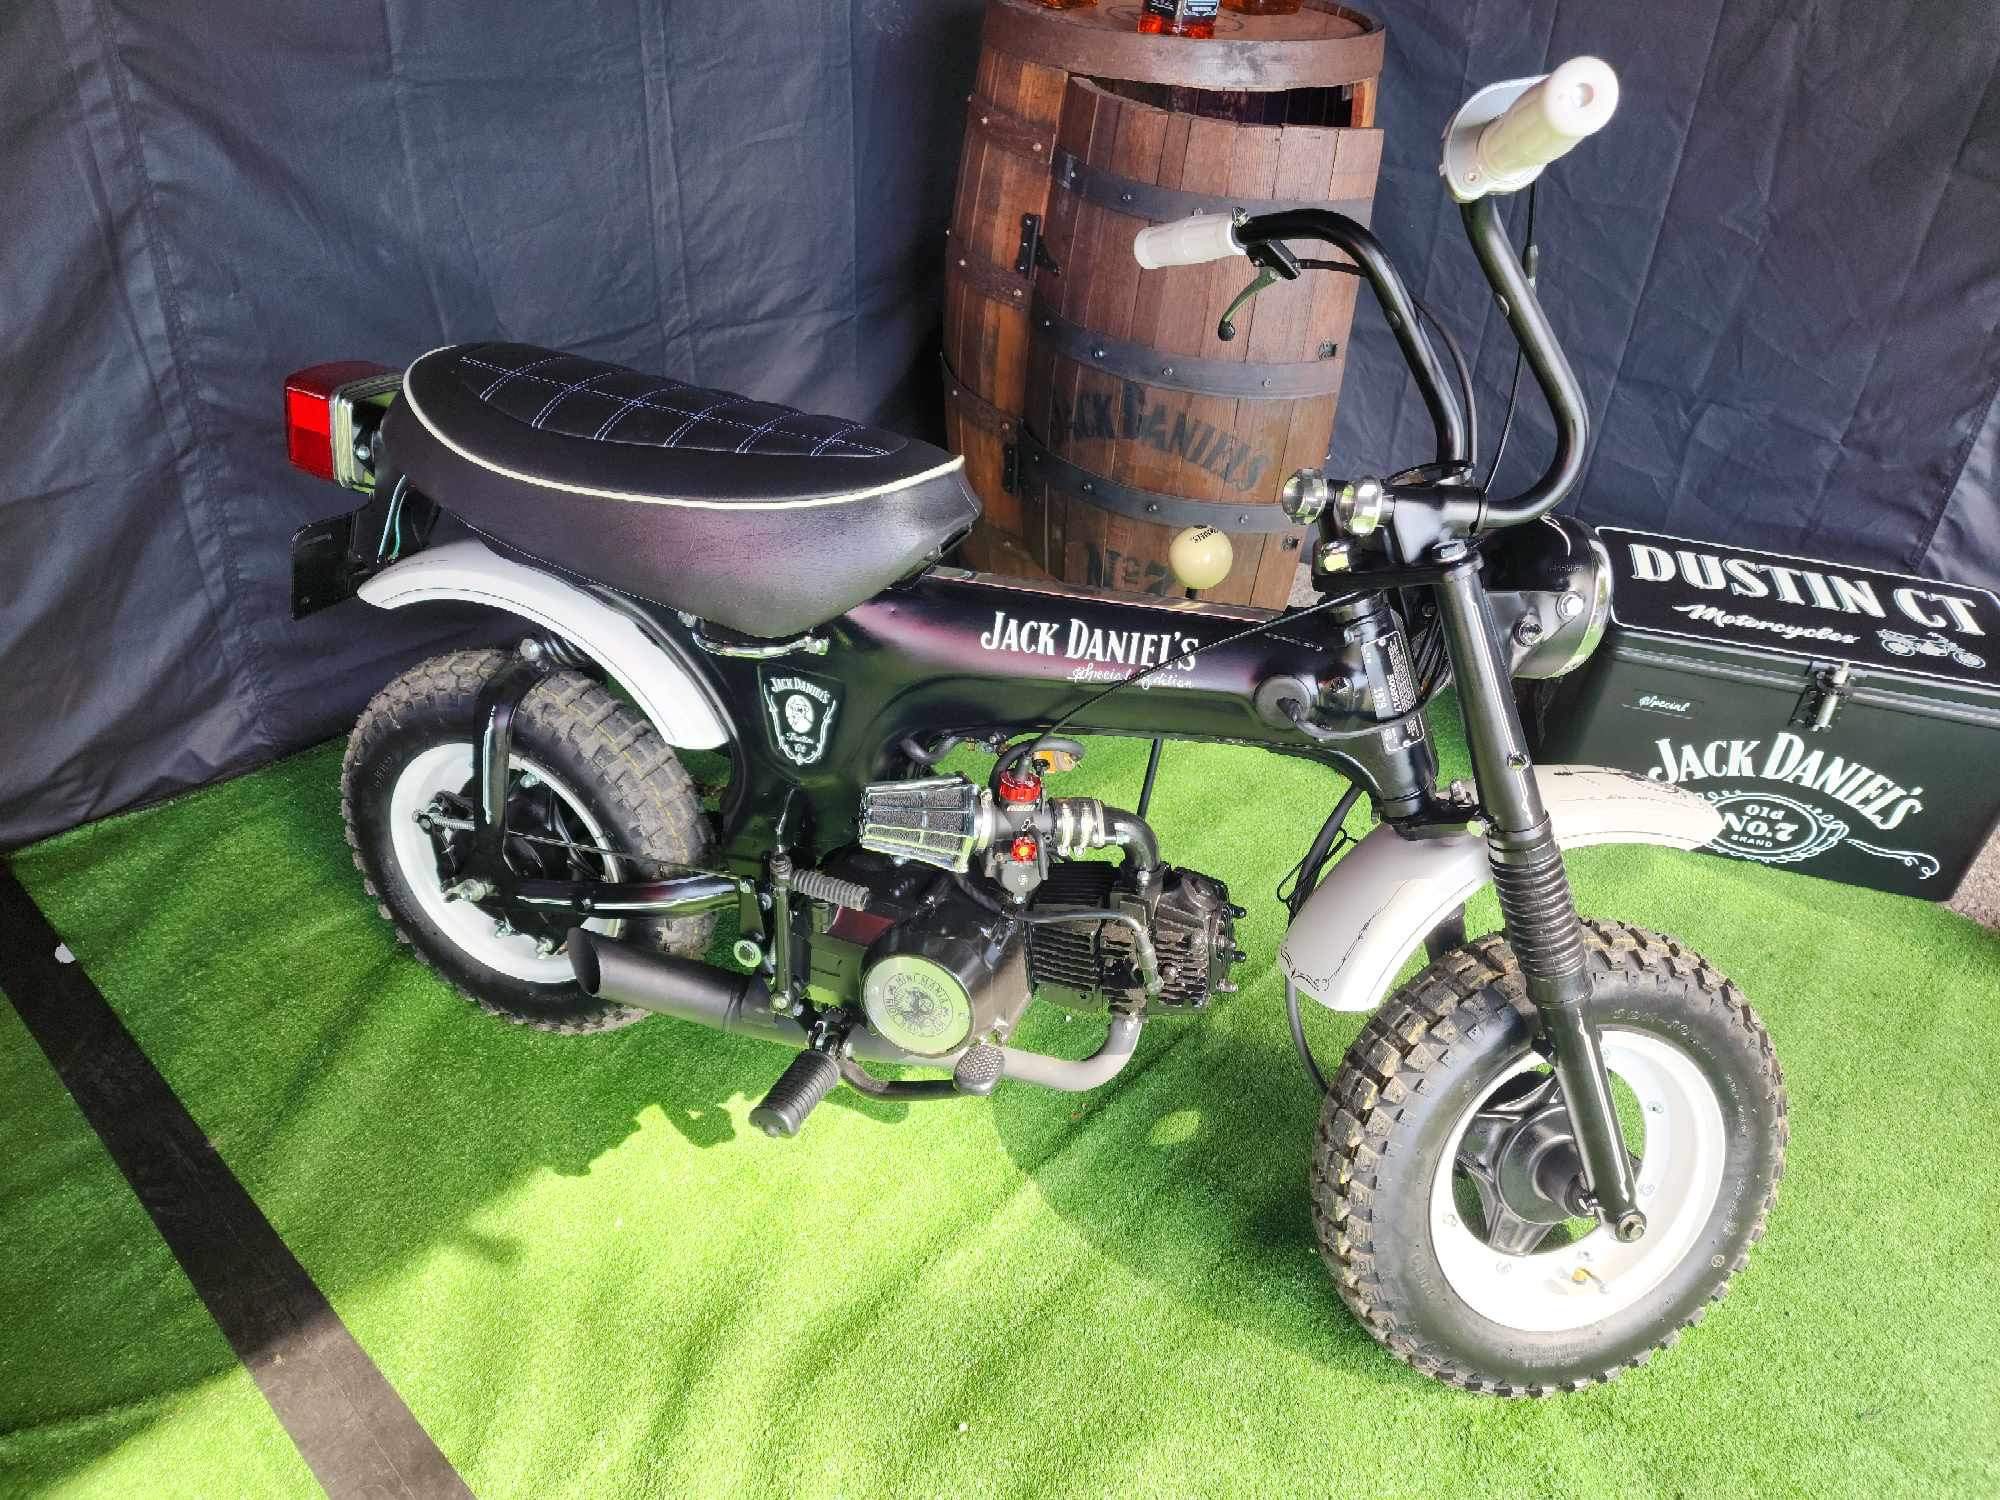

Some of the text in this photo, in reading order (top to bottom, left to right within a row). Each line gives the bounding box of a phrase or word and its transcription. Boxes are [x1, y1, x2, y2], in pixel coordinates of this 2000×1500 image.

[1628, 542, 1986, 637] DUSTIN CT
[980, 610, 1199, 672] JACK DANIEL'S
[1671, 603, 1861, 645] Motorcycles
[770, 677, 831, 704] JACK DANIEL'S
[1638, 695, 1691, 713] Special
[1648, 731, 1924, 831] JACK DANIEL'S
[1730, 834, 1773, 849] BRAND
